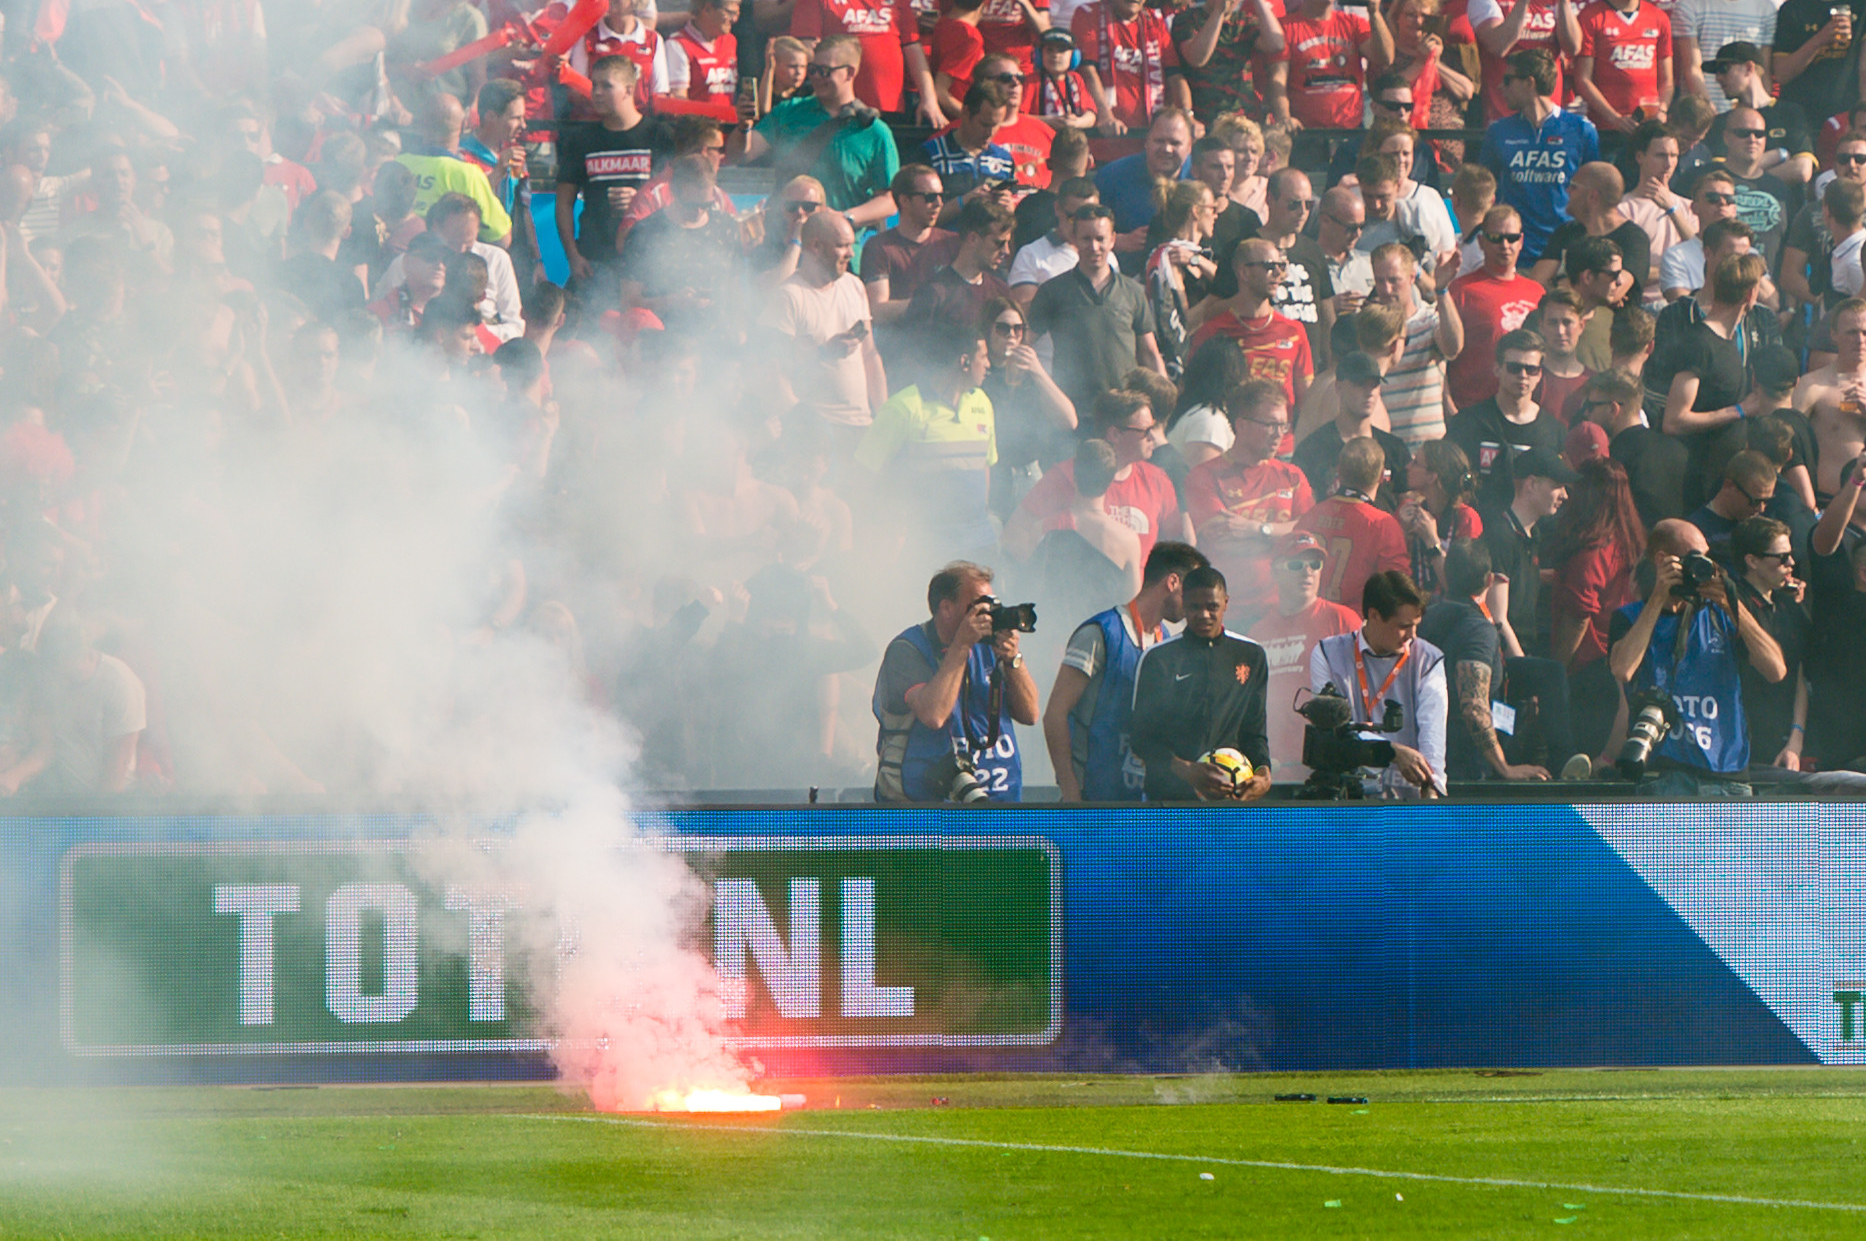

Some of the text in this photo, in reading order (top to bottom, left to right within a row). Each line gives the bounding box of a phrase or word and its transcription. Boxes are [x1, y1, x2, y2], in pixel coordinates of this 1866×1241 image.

[842, 7, 892, 25] AFAS
[1609, 44, 1656, 62] AFAS
[588, 157, 650, 175] ALKMAAR
[1510, 150, 1565, 169] AFAS
[1511, 168, 1565, 185] software
[974, 768, 1009, 792] 22
[213, 877, 915, 1025] TOTNL
